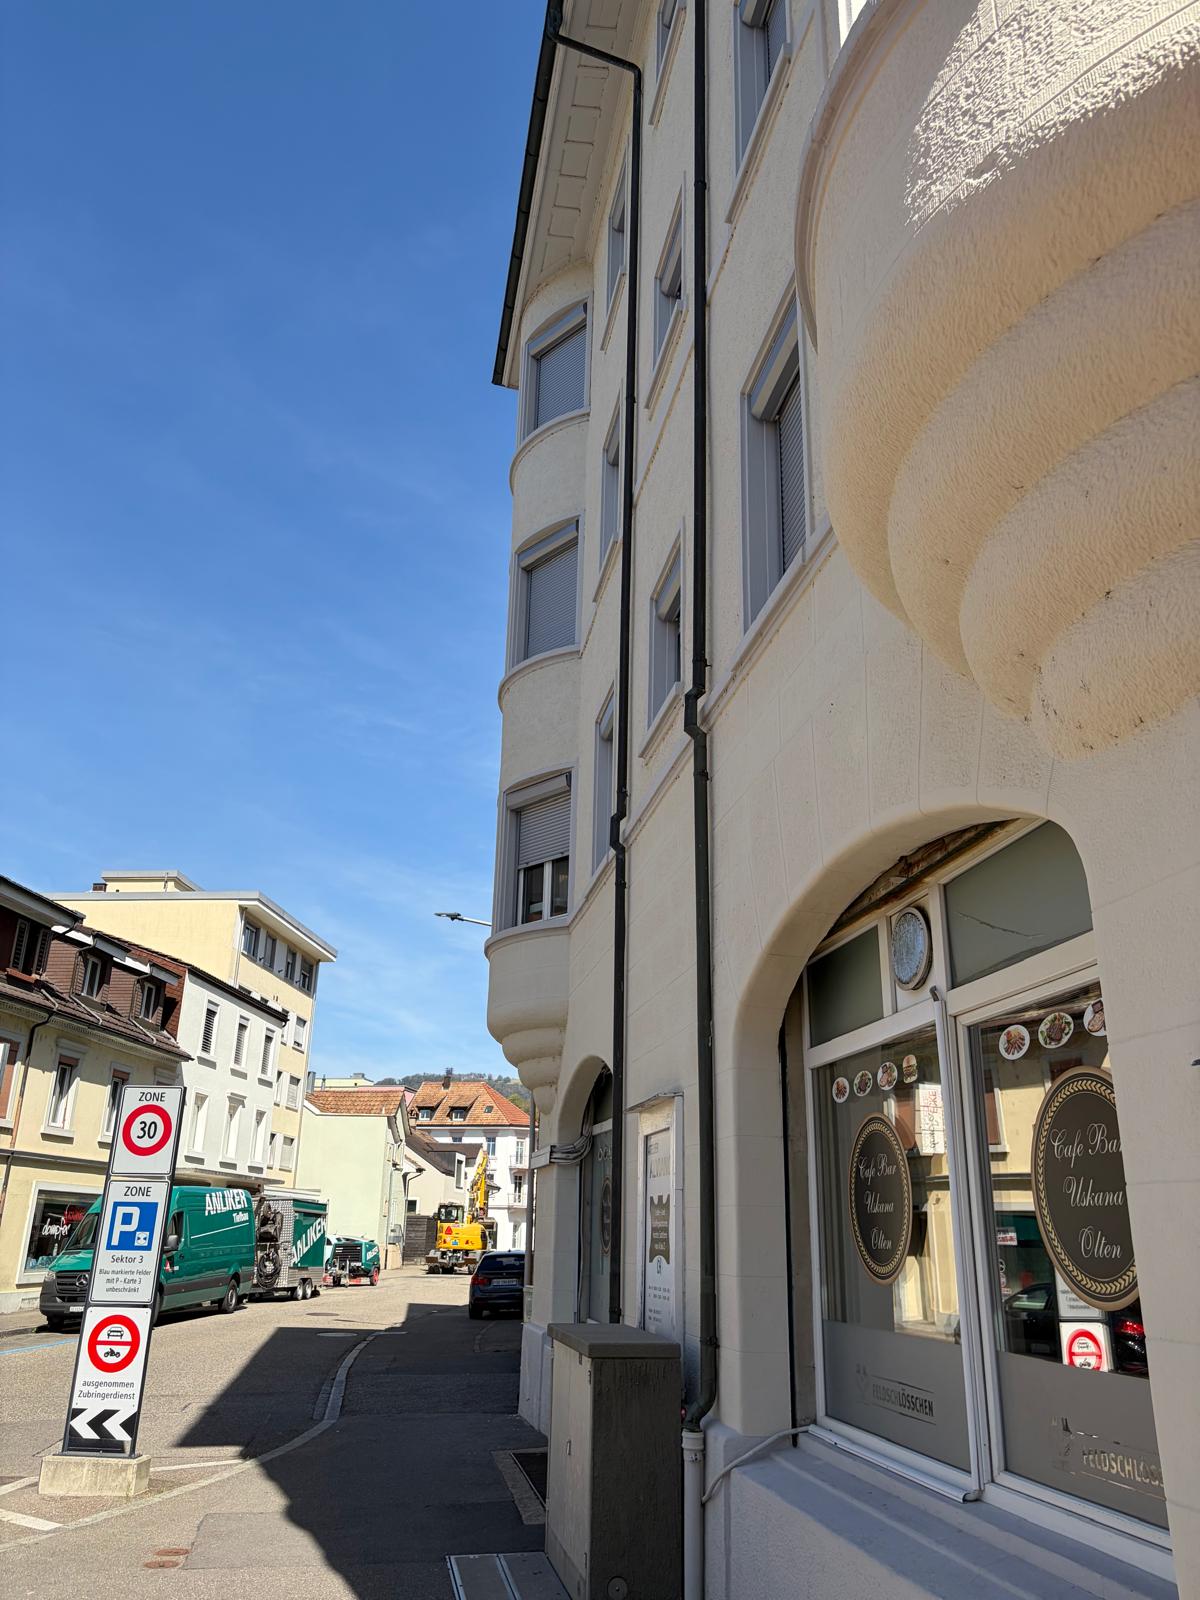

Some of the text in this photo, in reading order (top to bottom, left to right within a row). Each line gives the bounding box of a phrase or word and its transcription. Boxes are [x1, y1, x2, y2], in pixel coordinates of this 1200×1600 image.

[138, 1092, 166, 1102] ZONE
[136, 1121, 158, 1139] 30
[1050, 1128, 1085, 1168] Cafe
[858, 1154, 897, 1185] Cafe Bar
[123, 1186, 152, 1197] ZONE
[205, 1189, 248, 1217] ANLIKER
[864, 1190, 894, 1214] Uskana
[1062, 1176, 1124, 1208] Uskana
[871, 1227, 893, 1250] Olten
[1079, 1226, 1122, 1259] Olten
[111, 1254, 144, 1263] Sektor 3
[78, 1390, 136, 1400] Zubringerdienst
[82, 1380, 135, 1389] ausgenommen
